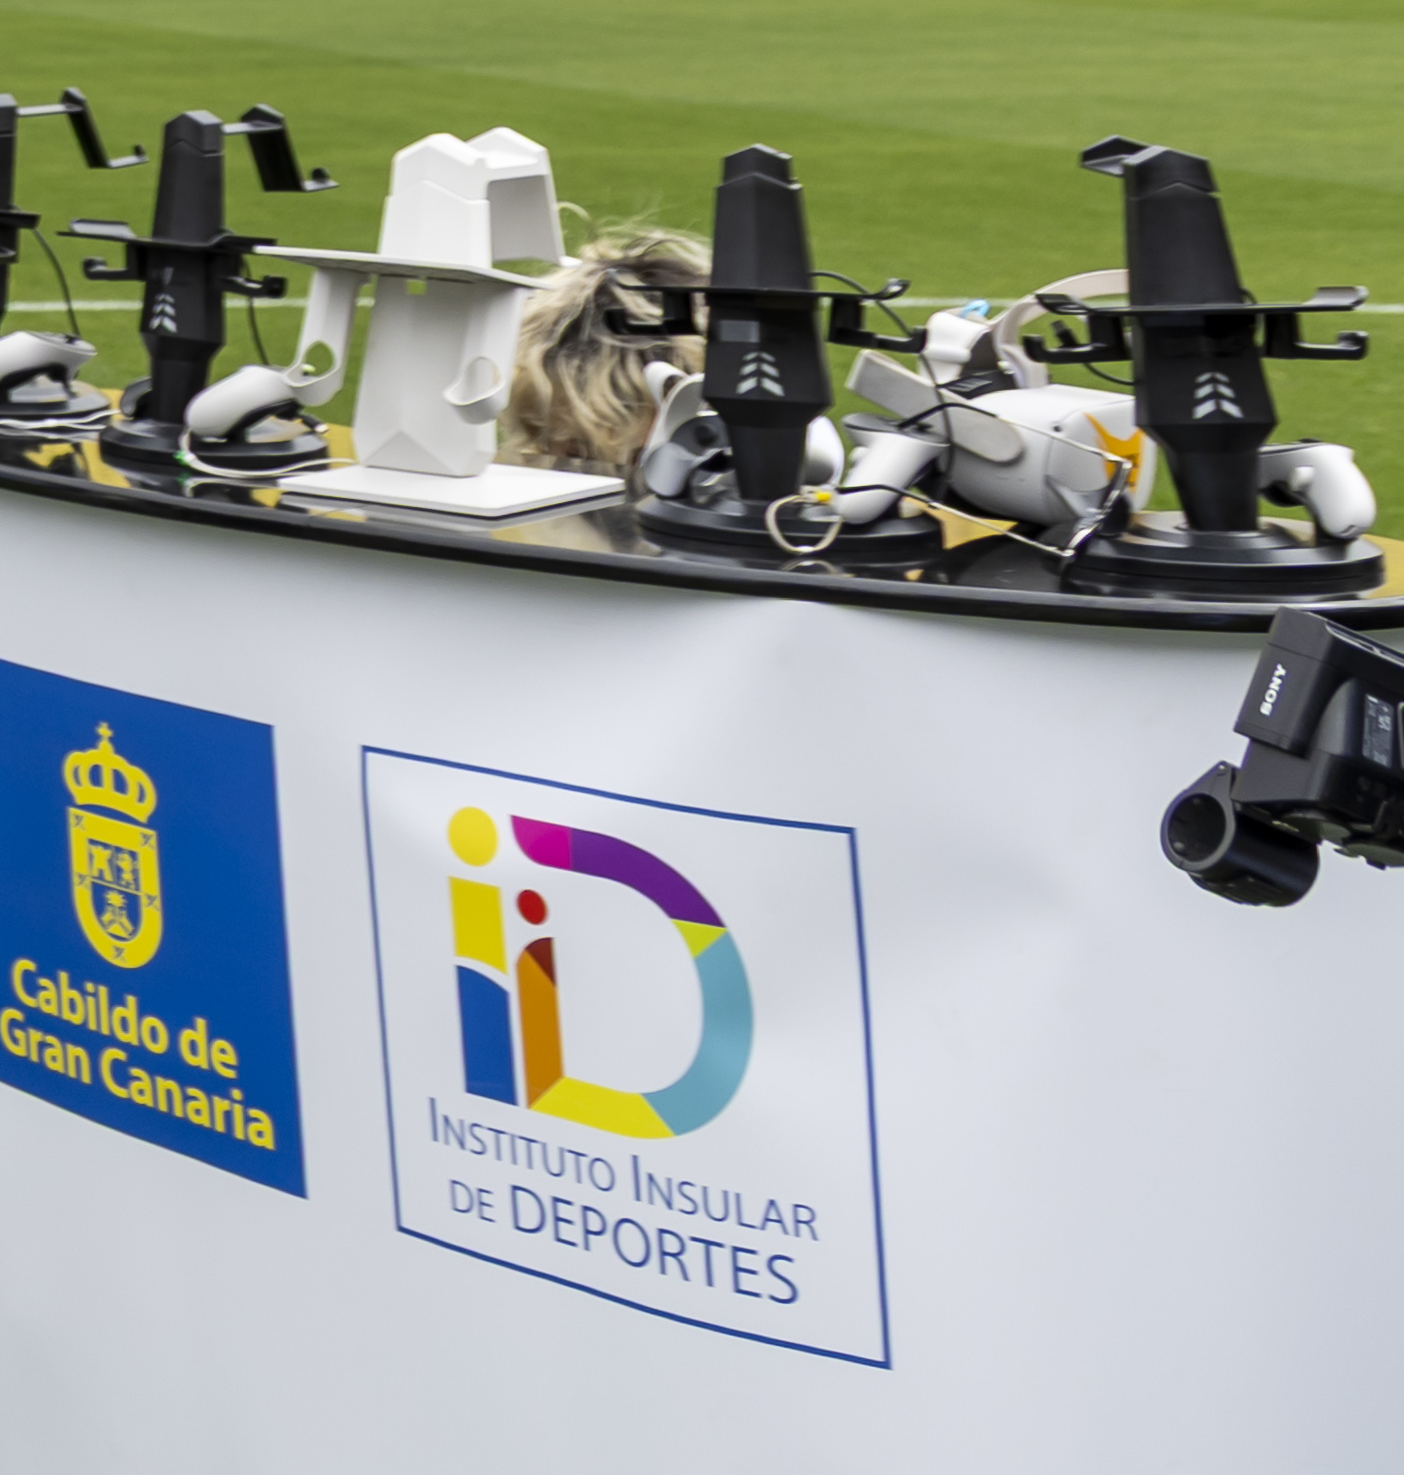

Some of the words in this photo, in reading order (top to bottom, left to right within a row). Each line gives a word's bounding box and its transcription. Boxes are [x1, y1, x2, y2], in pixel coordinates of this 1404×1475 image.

[1260, 663, 1287, 716] SONY
[0, 1008, 92, 1084] Gran
[101, 1048, 276, 1151] Canaria
[12, 959, 168, 1055] Cabildo
[180, 1018, 238, 1079] de
[428, 1097, 616, 1193] INSTITUTO
[631, 1154, 820, 1242] INSULAR
[511, 1184, 800, 1305] DEPORTES
